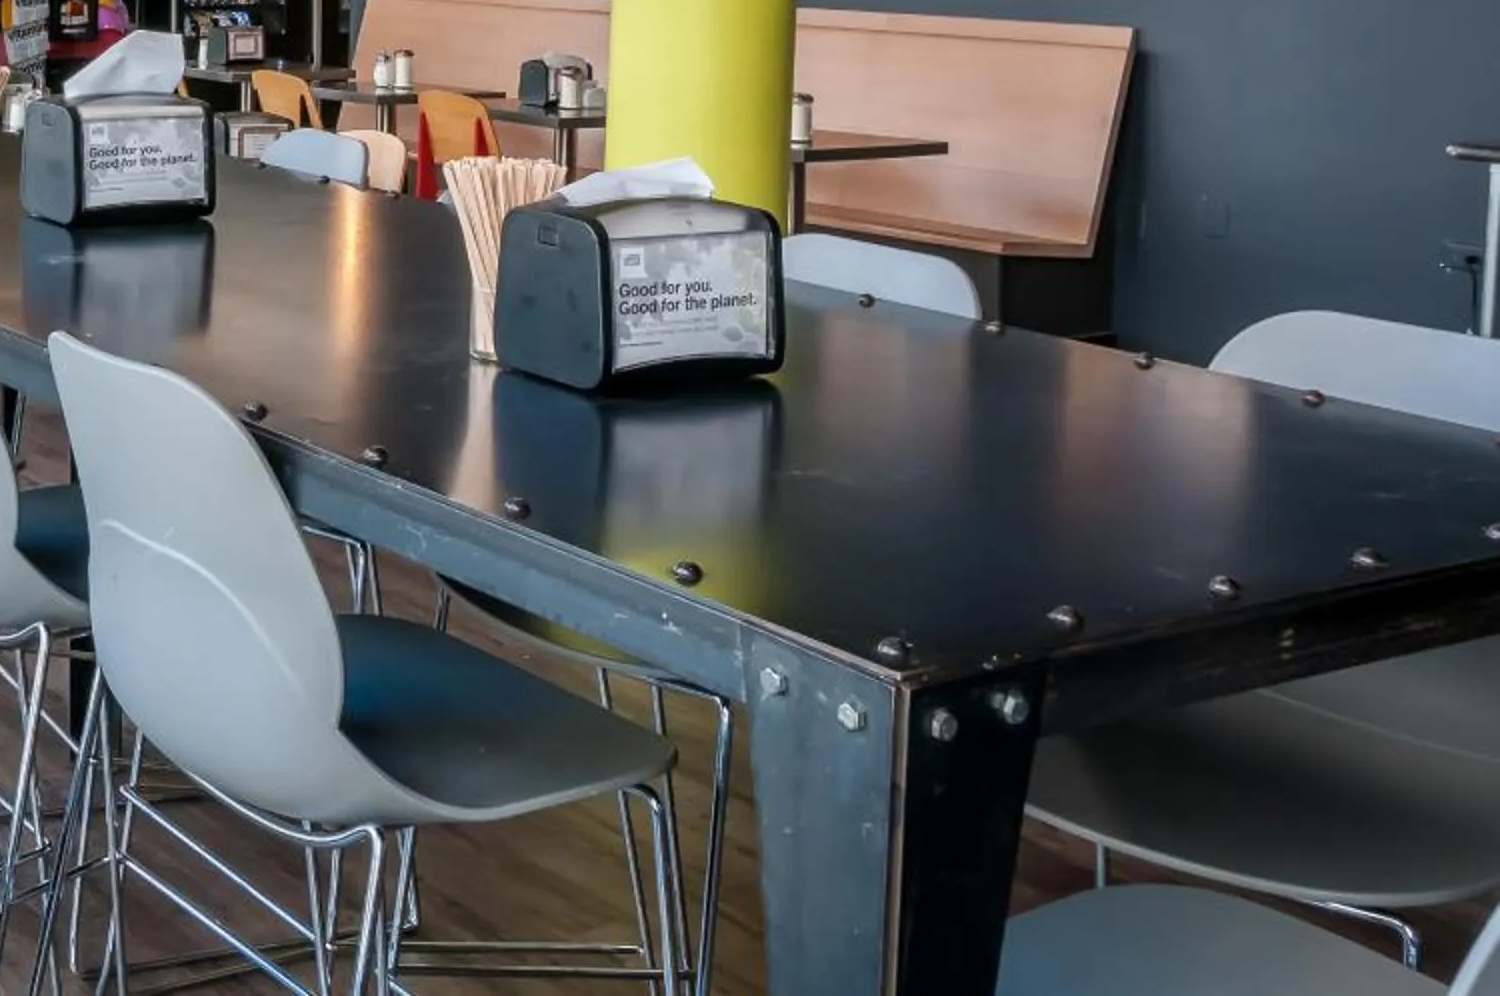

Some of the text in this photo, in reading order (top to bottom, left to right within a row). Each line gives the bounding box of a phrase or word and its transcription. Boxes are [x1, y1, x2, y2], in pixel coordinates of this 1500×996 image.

[89, 144, 162, 158] Good for you.
[89, 159, 119, 171] Good
[121, 157, 137, 170] for
[140, 154, 158, 167] the
[619, 280, 713, 298] Good for you.
[619, 292, 757, 316] Good for the planet.
